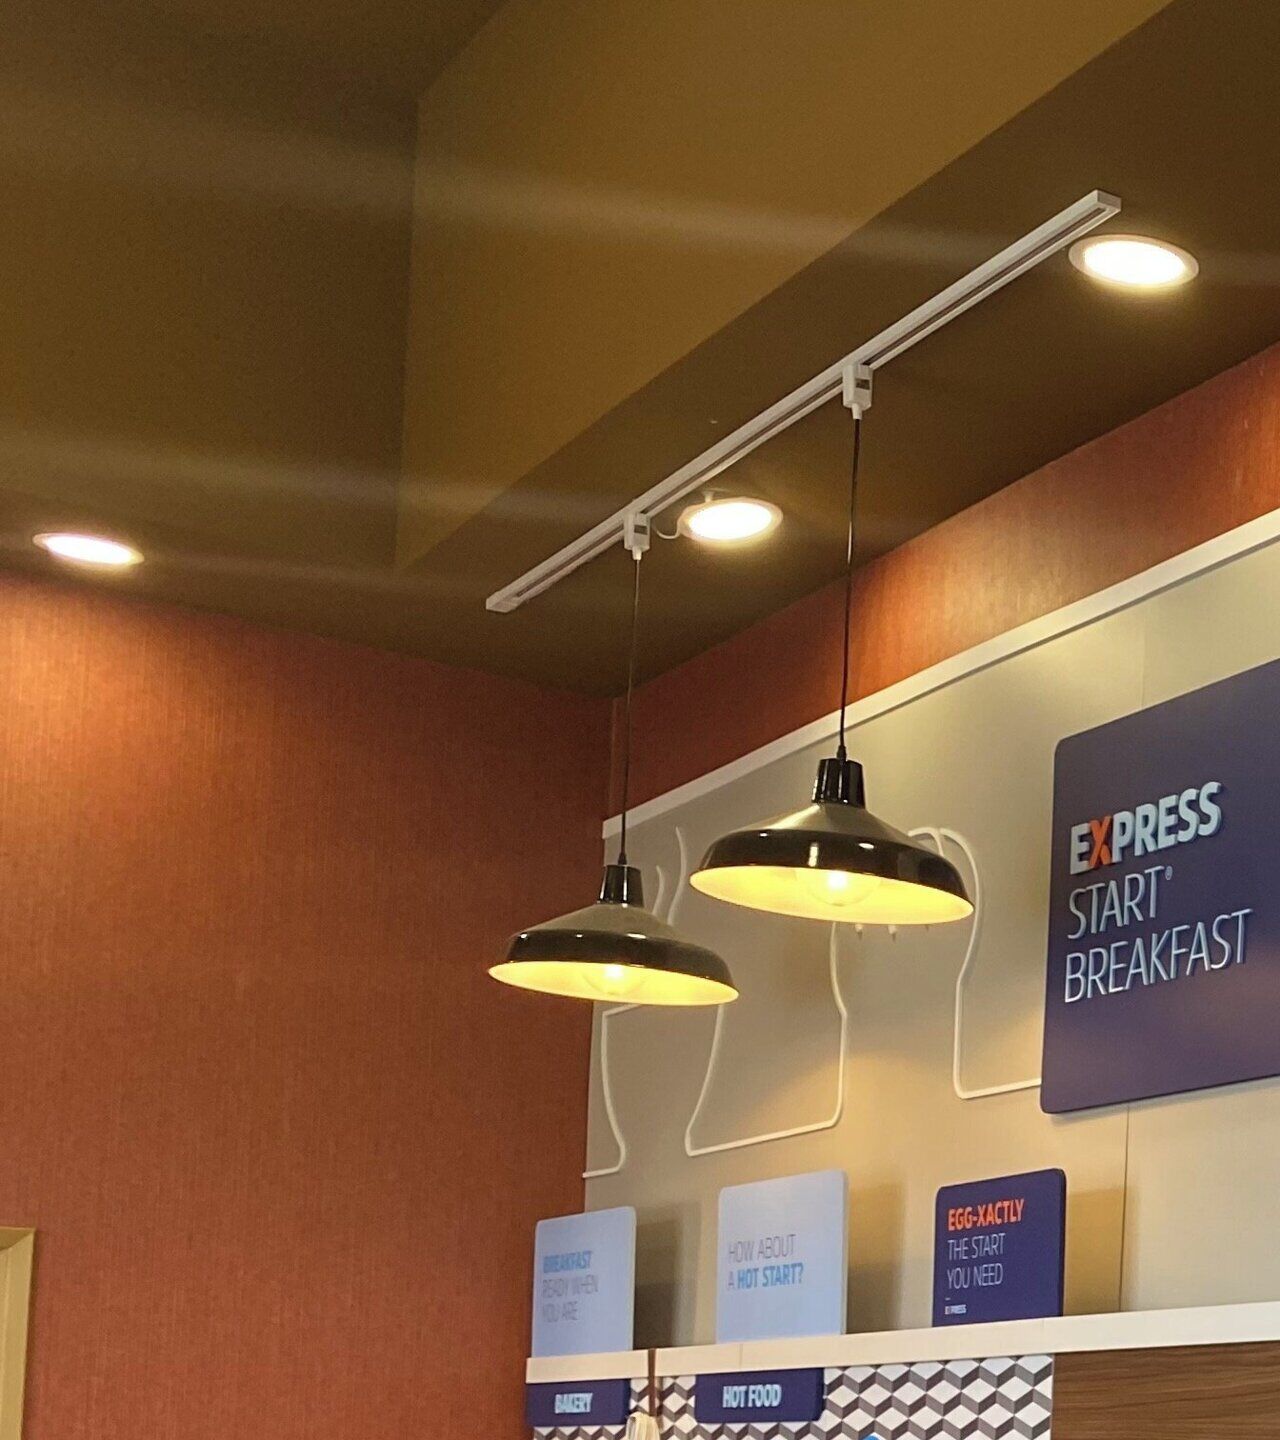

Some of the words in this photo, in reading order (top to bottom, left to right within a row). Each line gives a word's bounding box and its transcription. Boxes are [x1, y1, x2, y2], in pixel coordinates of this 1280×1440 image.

[1070, 781, 1222, 875] EXPRESS
[1065, 908, 1252, 1003] BREAKFAST
[948, 1198, 1024, 1231] EGG-XACTLY
[728, 1239, 755, 1263] HOW
[757, 1233, 796, 1260] ABOUT
[947, 1237, 969, 1261] THE
[972, 1232, 1006, 1259] START
[727, 1270, 735, 1291] A
[737, 1267, 759, 1289] HOT
[762, 1262, 804, 1287] START?
[947, 1266, 970, 1289] YOU
[973, 1262, 1004, 1287] NEED
[555, 1392, 593, 1414] BAKERY
[722, 1385, 747, 1408] HOT
[748, 1383, 782, 1407] FOOD
